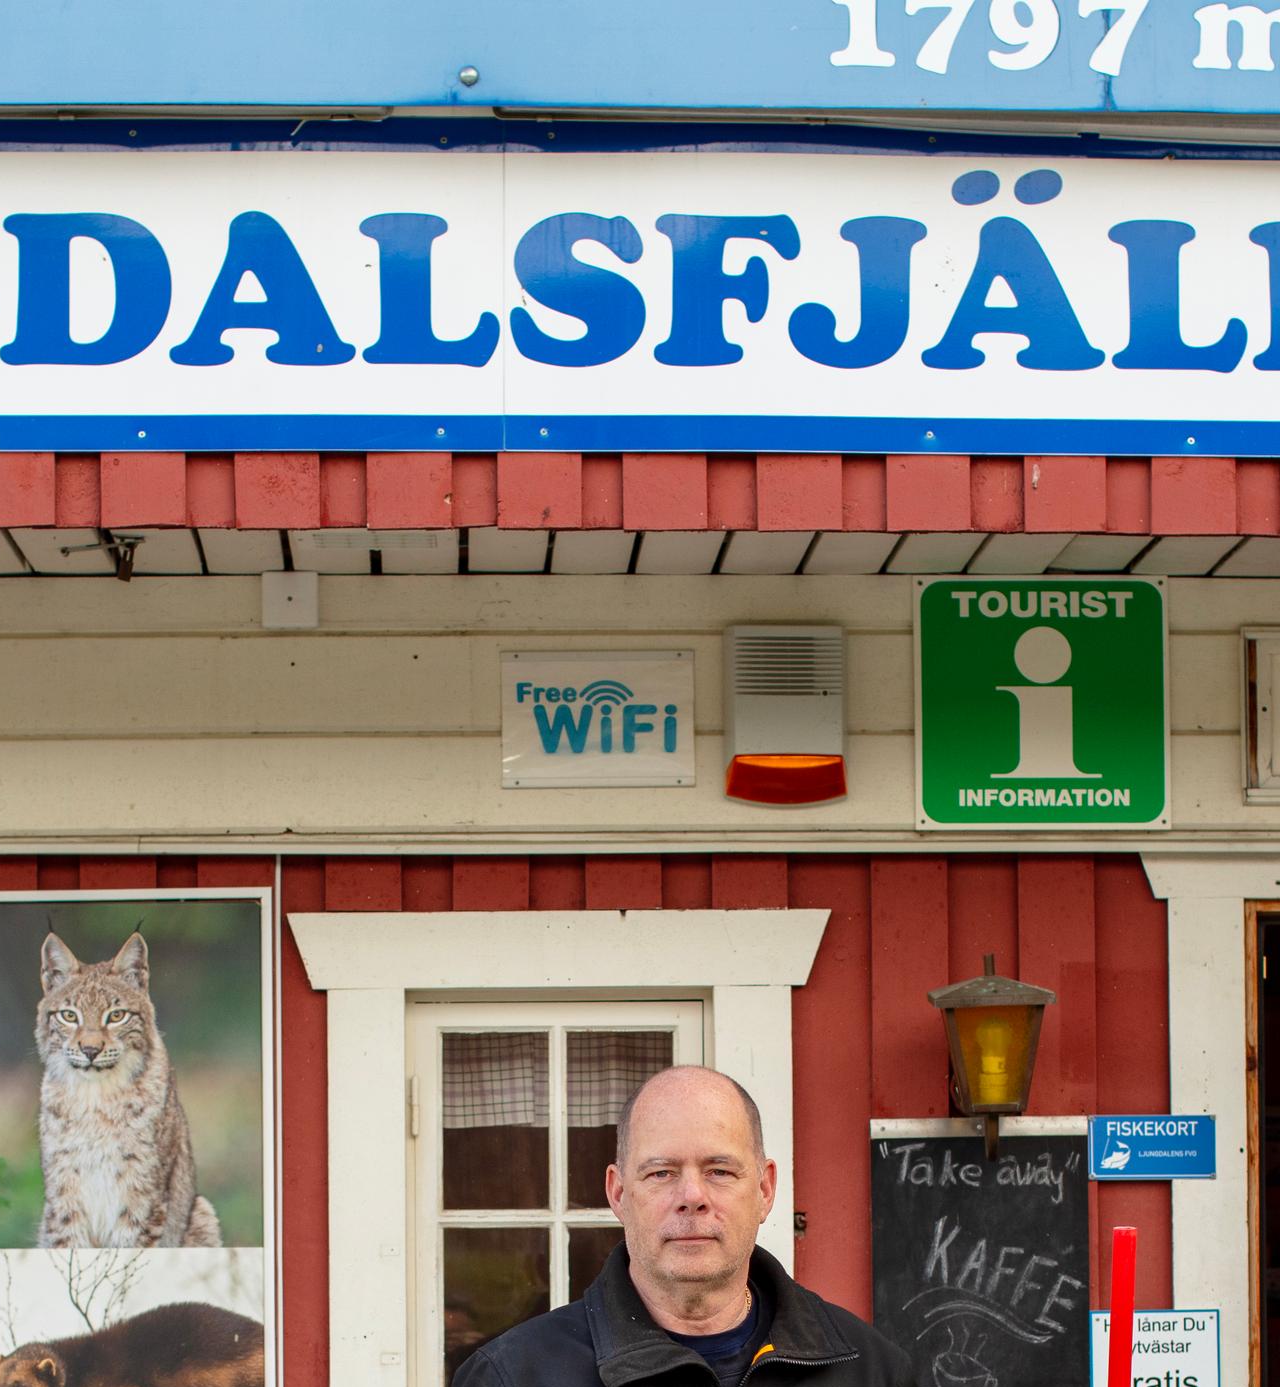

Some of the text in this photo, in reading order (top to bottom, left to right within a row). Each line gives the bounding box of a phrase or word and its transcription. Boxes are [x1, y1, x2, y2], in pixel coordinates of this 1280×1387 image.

[830, 0, 1148, 76] 1797
[951, 590, 1133, 618] TOURIST
[516, 682, 577, 703] Free
[533, 704, 678, 754] WiFi
[959, 788, 1131, 807] INFORMATION
[1106, 1121, 1198, 1136] FISKEKORT
[1138, 1150, 1184, 1158] LJUNGDALENS
[924, 1214, 1084, 1334] KAFFE
[1137, 1317, 1206, 1332] lånar Du
[1131, 1340, 1192, 1356] ytvästar
